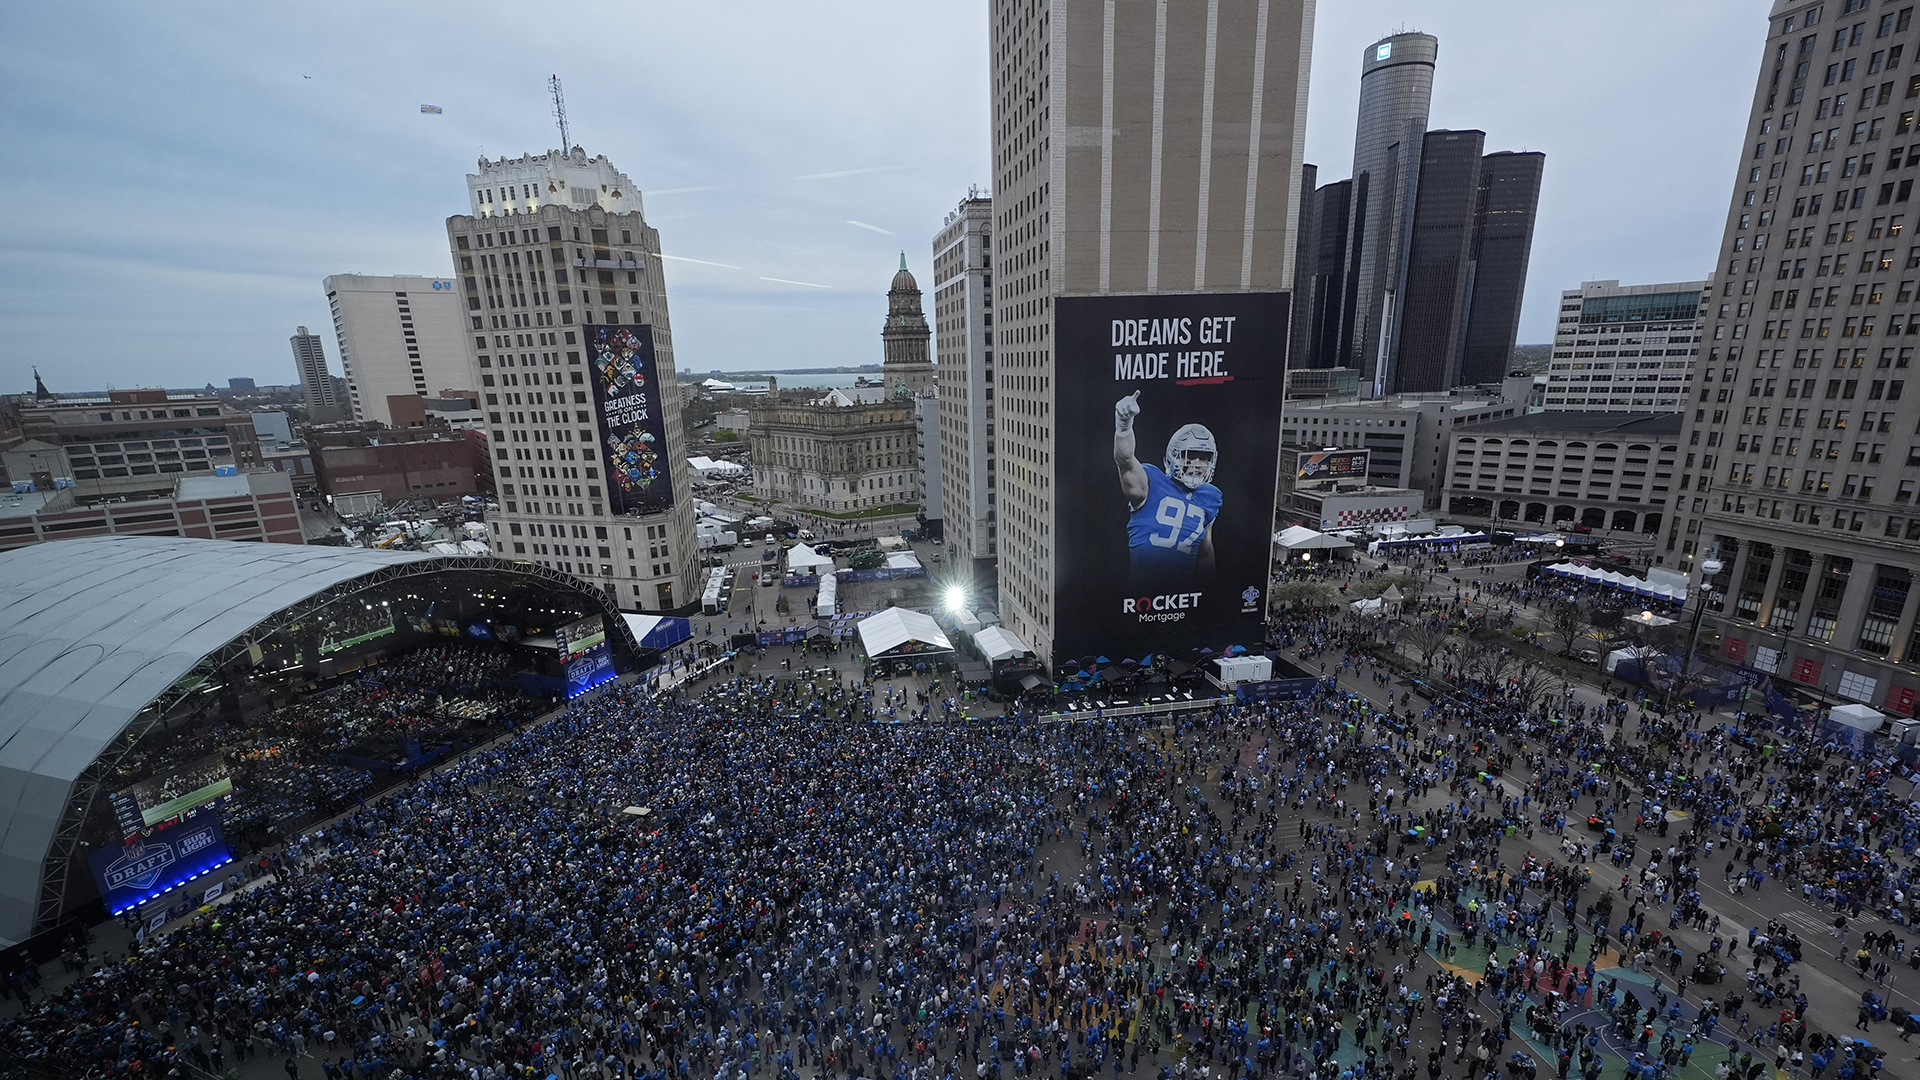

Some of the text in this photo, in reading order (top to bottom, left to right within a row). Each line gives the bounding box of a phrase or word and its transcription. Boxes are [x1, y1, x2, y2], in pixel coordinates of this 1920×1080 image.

[1111, 316, 1236, 347] DREAMS GET
[1115, 350, 1228, 380] MADE HERE.
[604, 393, 646, 412] GREATNESS
[606, 408, 649, 428] THE CLOCK
[1149, 495, 1206, 554] 97
[1123, 592, 1202, 614] ROCKET
[1138, 611, 1186, 623] Mortgage
[570, 664, 593, 679] DRAFT
[158, 818, 178, 831] 5:47
[180, 835, 213, 856] LIGHT
[183, 831, 207, 847] BUD
[127, 846, 146, 859] NFL
[111, 852, 168, 884] DRAFT
